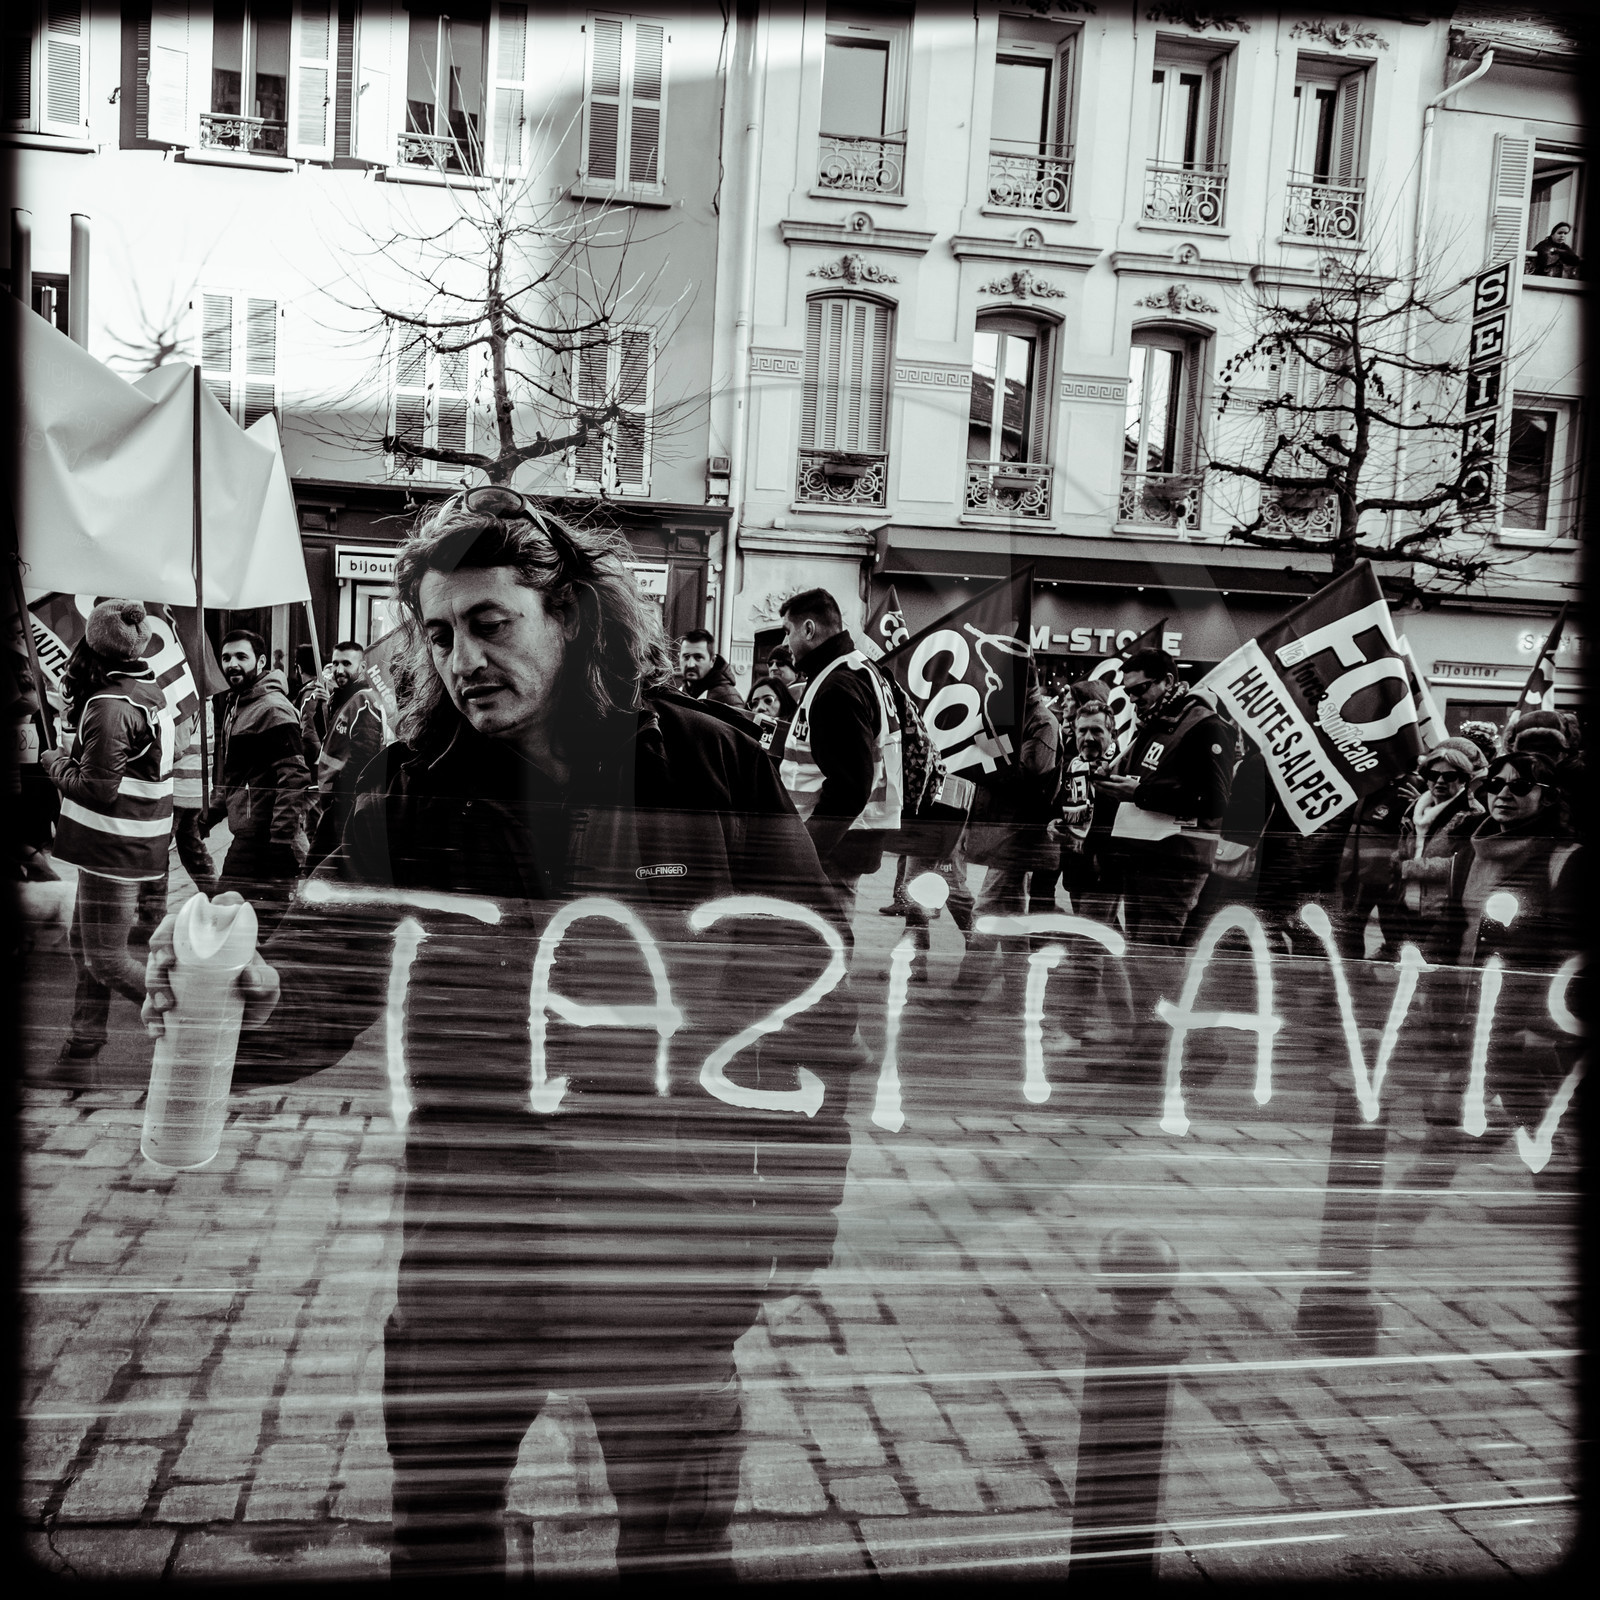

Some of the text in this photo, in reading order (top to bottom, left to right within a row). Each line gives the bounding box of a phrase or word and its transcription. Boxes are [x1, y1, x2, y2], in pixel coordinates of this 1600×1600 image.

[1460, 269, 1507, 503] SEIKO
[350, 559, 394, 574] bijout
[1030, 624, 1184, 659] M-STOE
[1275, 600, 1418, 742] FO
[1432, 663, 1499, 678] bijoutier
[1227, 665, 1343, 820] HAUTES-ALPES
[639, 865, 683, 877] PALFINGER
